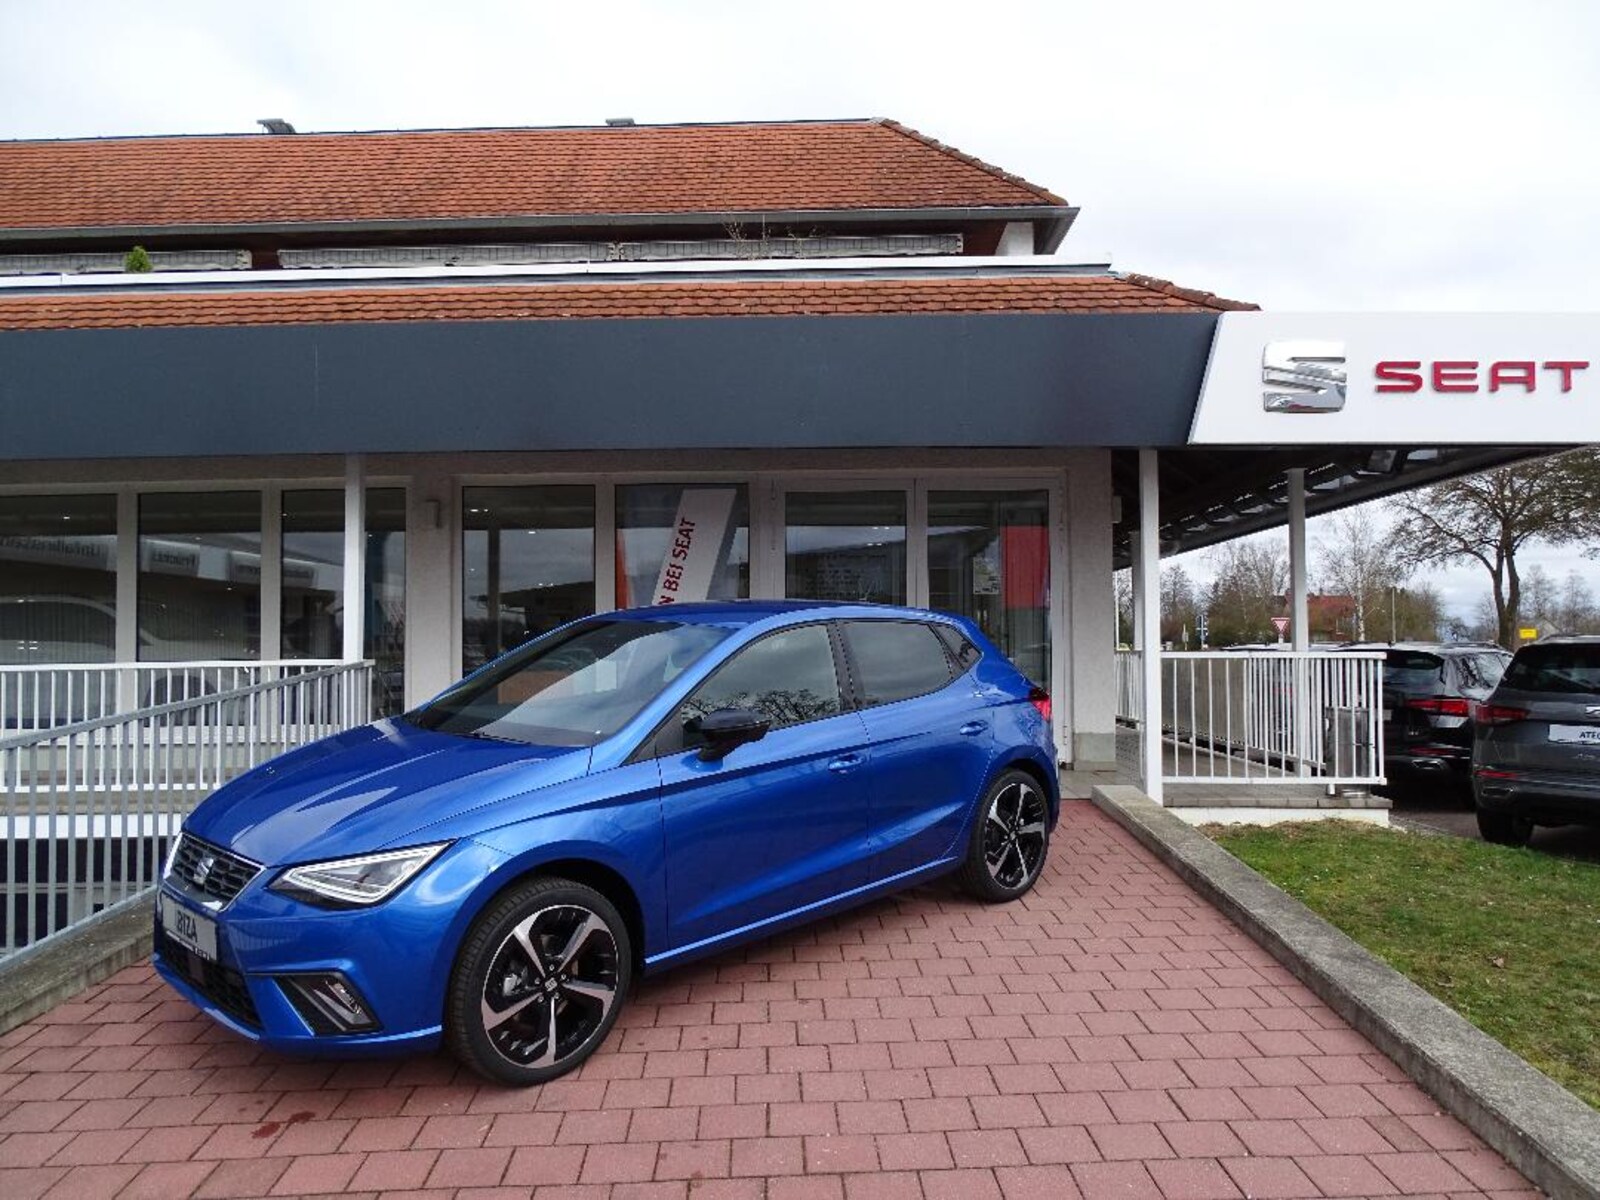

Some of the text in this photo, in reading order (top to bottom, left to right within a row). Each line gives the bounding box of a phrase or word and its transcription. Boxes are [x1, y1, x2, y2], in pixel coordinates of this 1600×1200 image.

[1375, 360, 1590, 394] SEAT
[672, 516, 696, 561] SEAT
[663, 563, 684, 592] BEI
